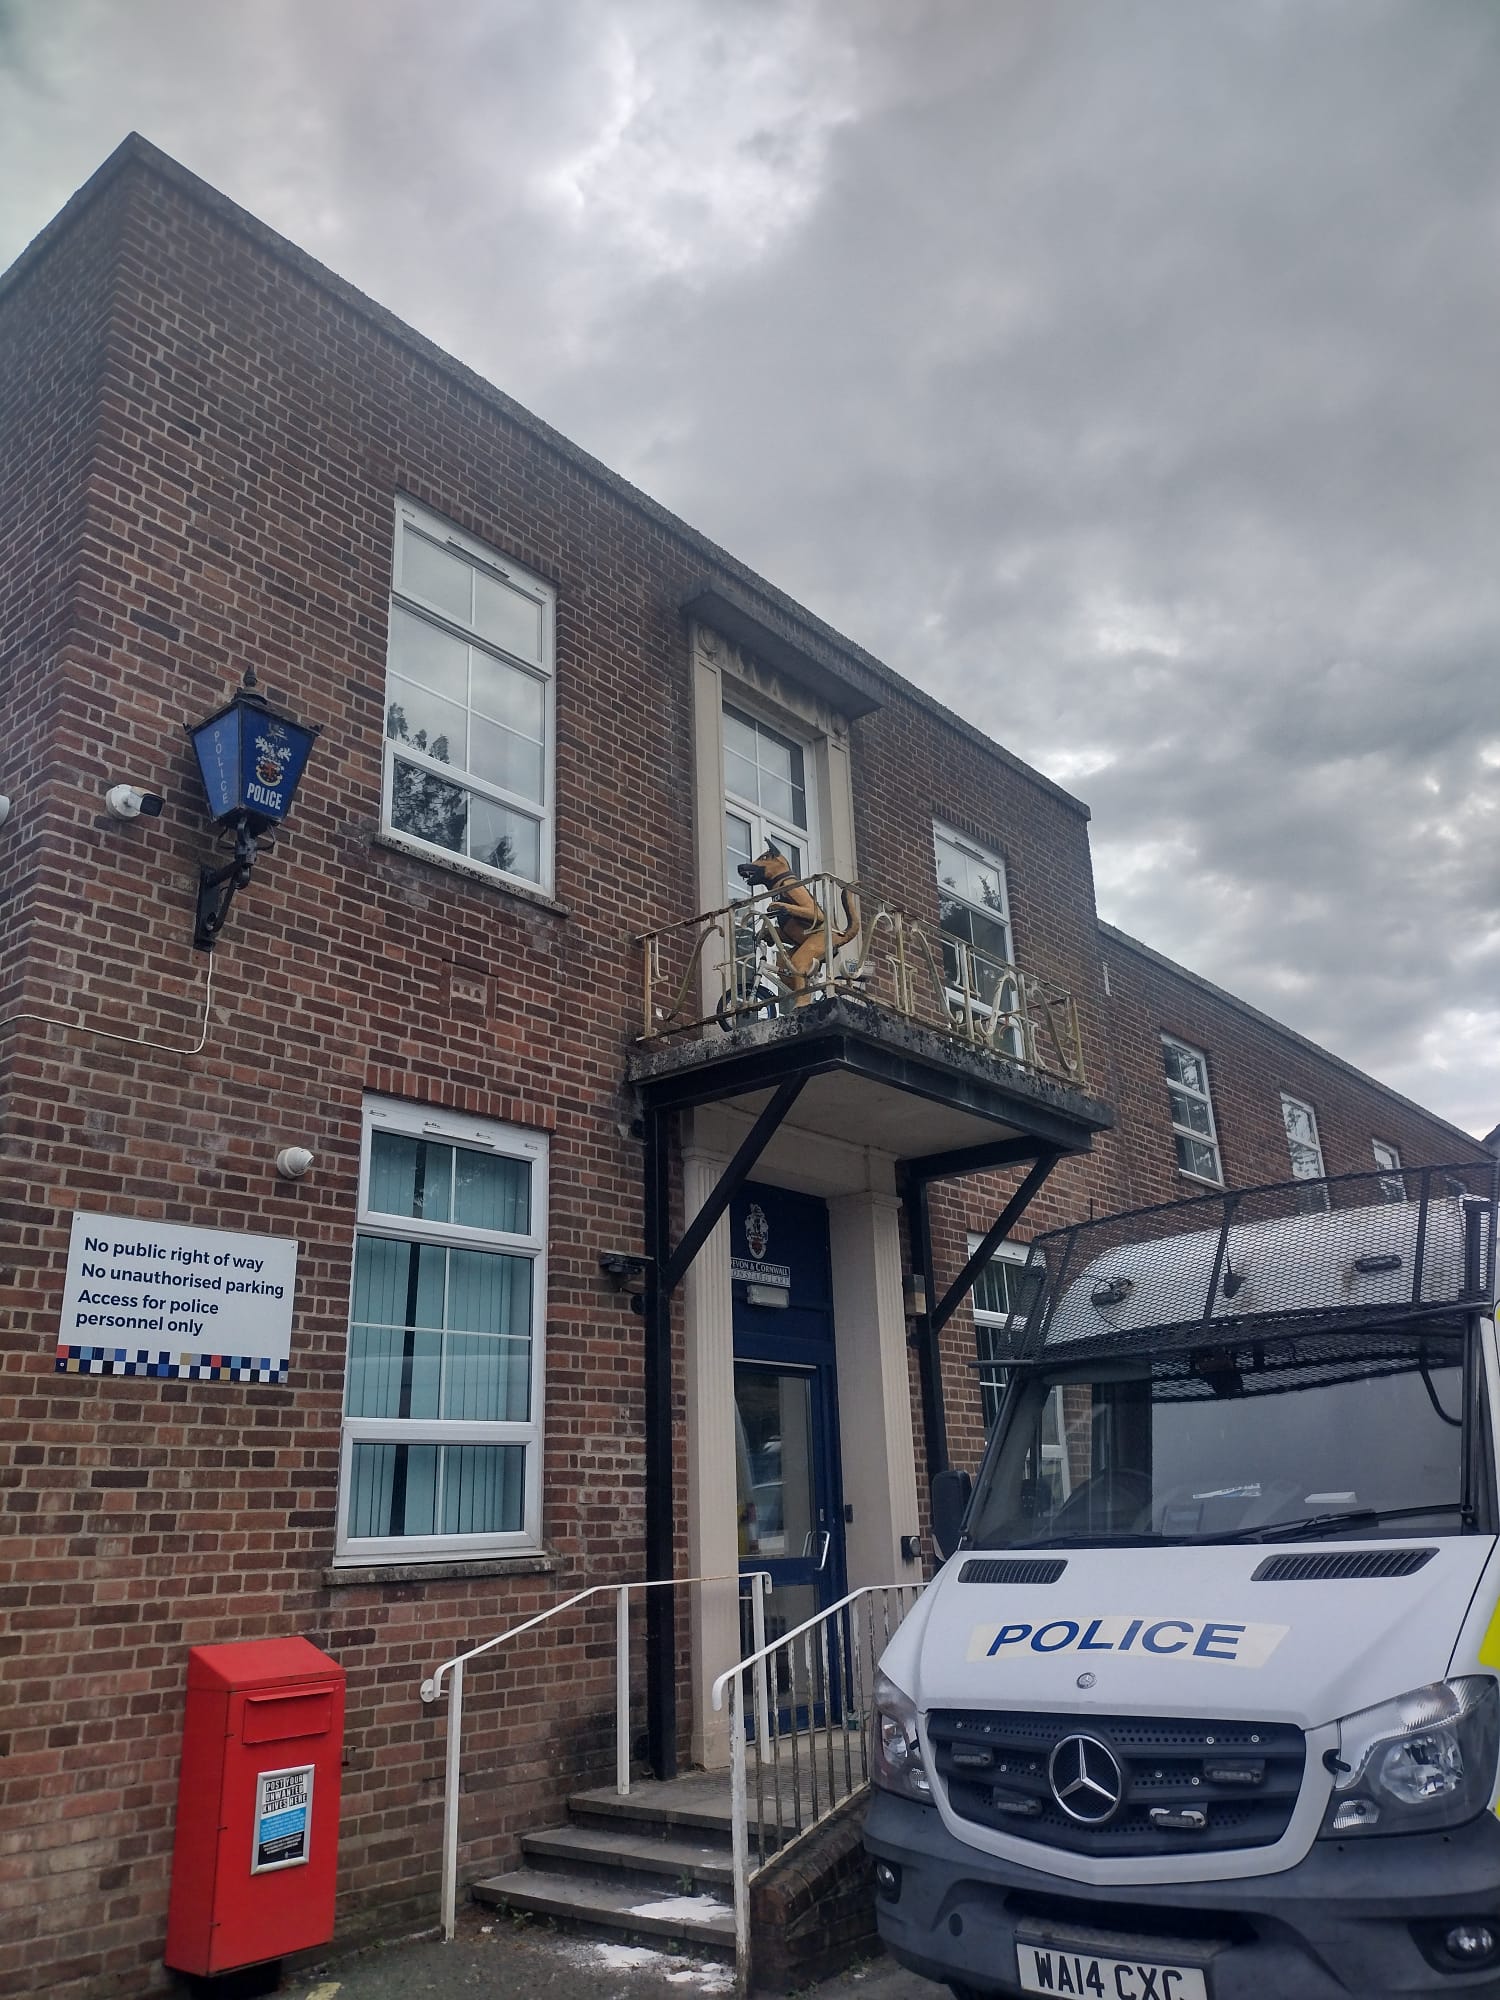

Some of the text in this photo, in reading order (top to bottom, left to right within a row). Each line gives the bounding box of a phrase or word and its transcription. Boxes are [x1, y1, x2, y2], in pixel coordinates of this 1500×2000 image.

[247, 783, 282, 810] POLICE
[84, 1237, 264, 1273] No public right of way
[81, 1263, 284, 1299] No unauthorised parking
[77, 1289, 219, 1315] Access for police
[75, 1312, 203, 1336] personnel only
[986, 1619, 1247, 1660] POLICE
[266, 1774, 303, 1792] POST YOUR
[266, 1785, 304, 1802] UNWANTED
[263, 1794, 307, 1813] KNIVES HERE
[1034, 1950, 1183, 2000] WA14 CXC
